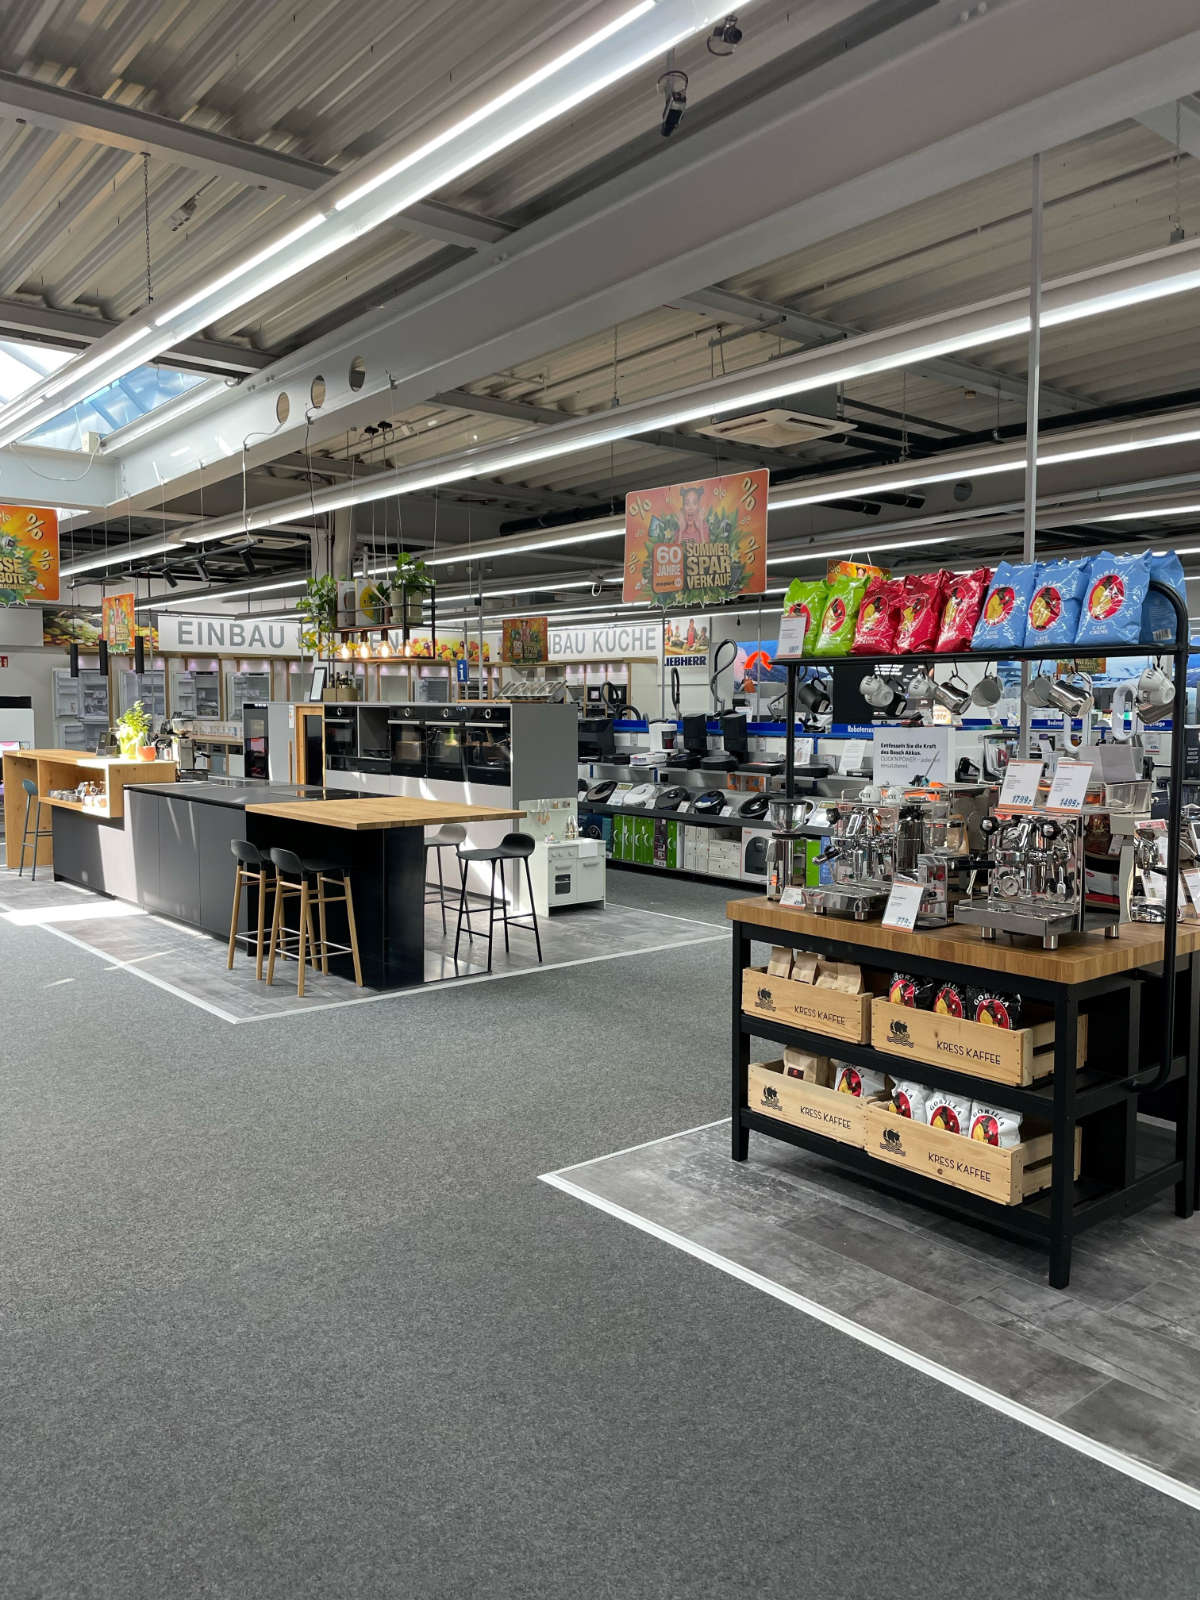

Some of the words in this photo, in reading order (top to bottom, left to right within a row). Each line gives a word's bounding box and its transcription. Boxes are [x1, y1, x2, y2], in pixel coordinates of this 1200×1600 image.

[656, 546, 681, 564] 60
[686, 543, 730, 556] SOMMER
[0, 557, 24, 573] SE
[656, 564, 681, 577] JAHRE
[686, 555, 731, 576] SPAR
[686, 572, 732, 590] VERKAUF
[178, 621, 285, 649] EINBAU
[592, 625, 656, 653] KÜCHE
[973, 992, 1010, 1009] GORILLA
[793, 1005, 817, 1019] KRESS
[816, 1009, 847, 1026] KAFFEE
[936, 1040, 964, 1056] KRESS
[965, 1048, 1001, 1065] KAFFEE
[799, 1105, 823, 1121] KRESS
[822, 1110, 852, 1130] KAFFEE
[929, 1098, 962, 1118] GORILLA
[971, 1107, 1006, 1128] GORILLA
[928, 1151, 955, 1170] KRESS
[956, 1162, 992, 1183] KAFFEE
